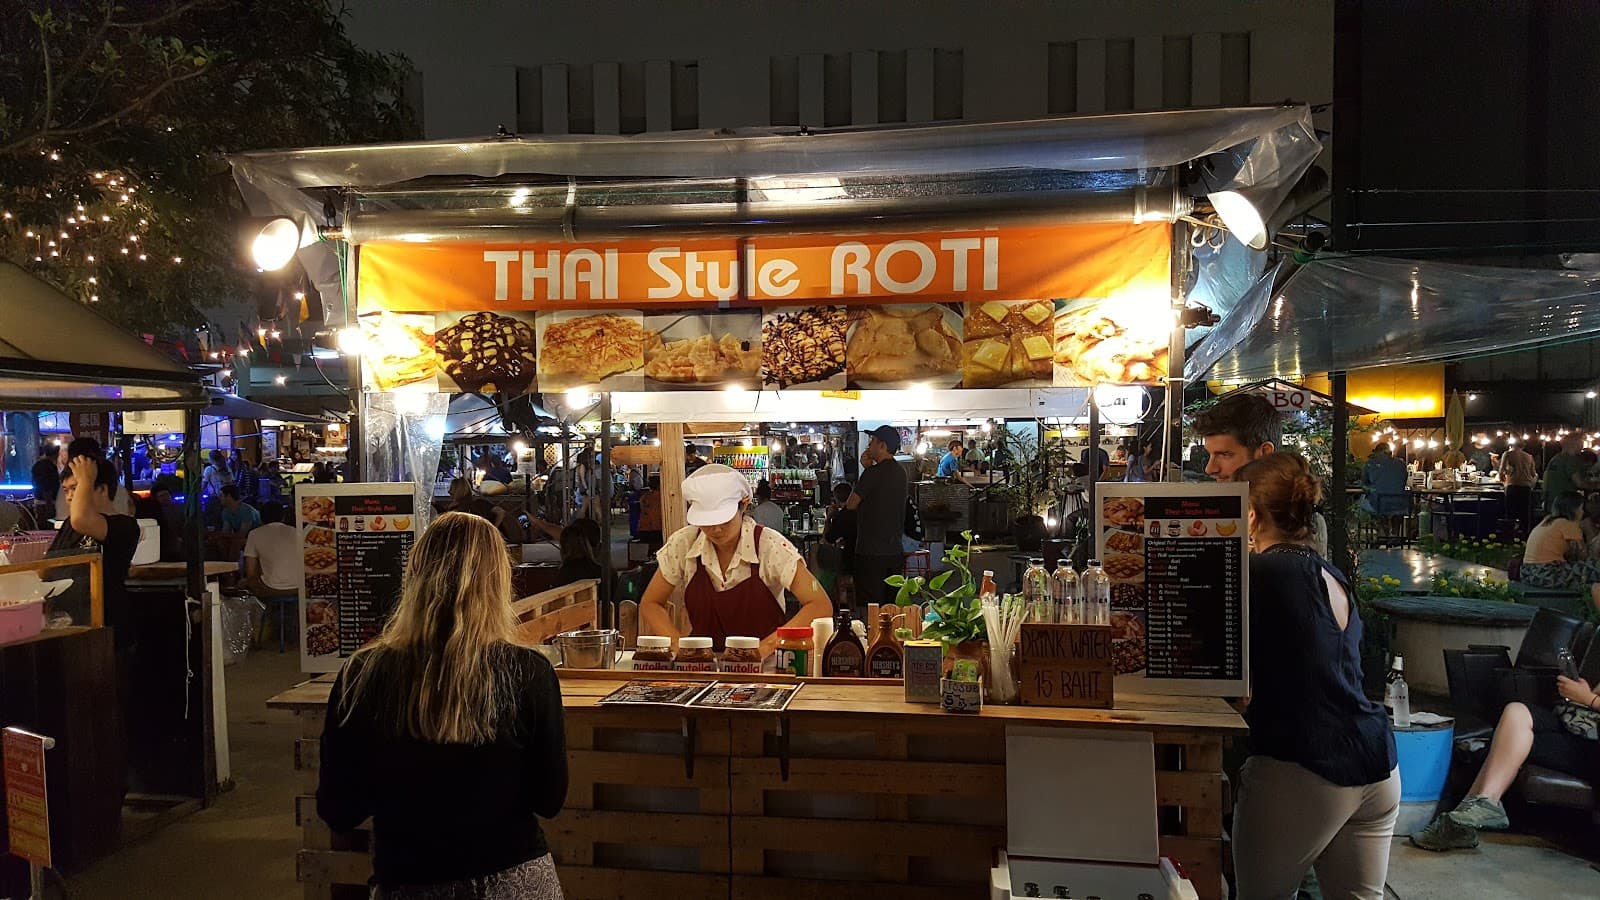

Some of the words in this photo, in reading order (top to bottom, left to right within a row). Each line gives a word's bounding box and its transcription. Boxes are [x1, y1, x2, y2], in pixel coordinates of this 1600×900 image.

[483, 248, 618, 301] THAI
[647, 243, 801, 308] Style
[830, 236, 999, 296] ROTI
[1021, 629, 1065, 659] DRINK
[1070, 629, 1113, 660] WATER
[633, 661, 669, 671] nutella
[676, 662, 711, 672] nutella
[724, 663, 760, 674] nutella
[1034, 670, 1053, 698] 15
[1060, 670, 1103, 698] BAHT
